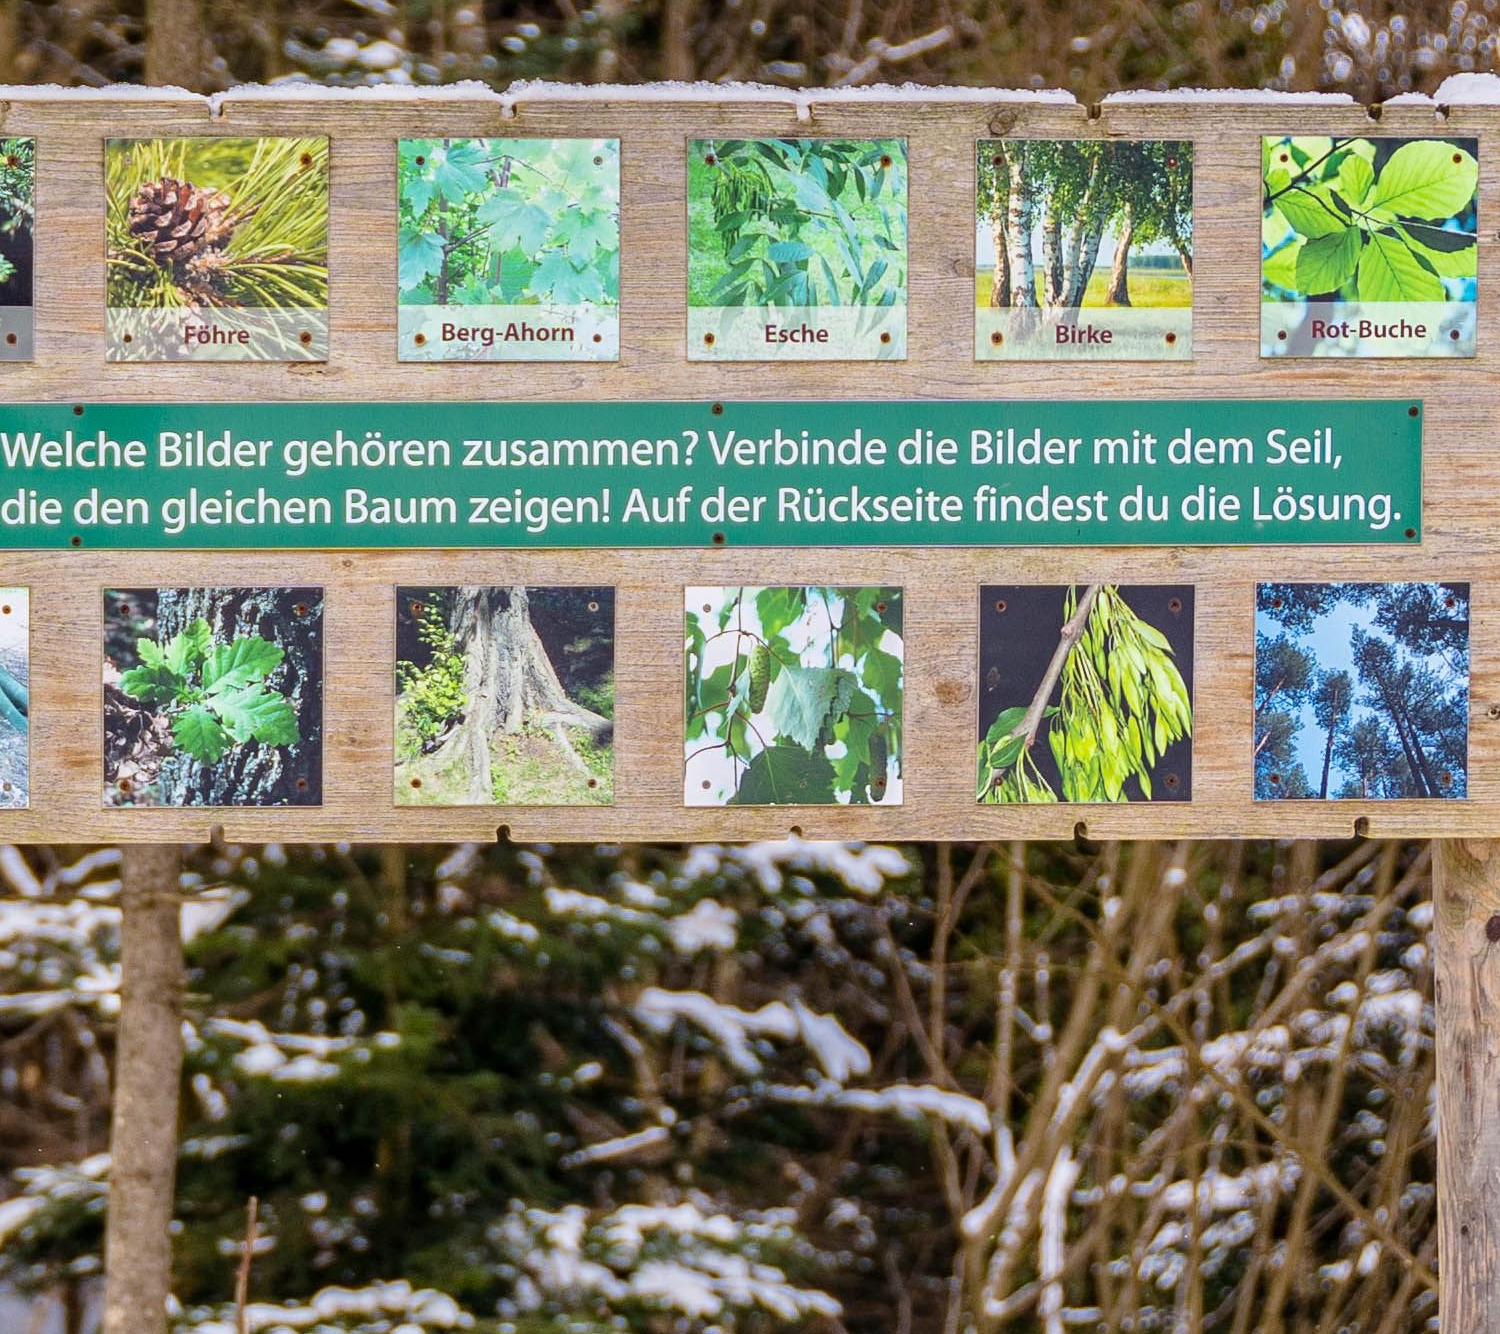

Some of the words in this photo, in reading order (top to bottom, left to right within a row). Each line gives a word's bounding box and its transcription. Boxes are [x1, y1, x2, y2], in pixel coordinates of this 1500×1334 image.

[184, 324, 250, 345] Föhre
[441, 322, 575, 347] Berg-Ahorn
[764, 323, 829, 344] Esche
[1055, 324, 1113, 345] Birke
[1311, 319, 1427, 339] Rot-Buche
[0, 430, 147, 468] Welche
[159, 430, 272, 468] Bilder
[283, 430, 451, 476] gehören
[462, 430, 699, 467] zusammen?
[707, 429, 887, 466] Verbinde
[899, 429, 959, 466] die
[971, 429, 1081, 466] Bilder
[1093, 428, 1156, 465] mit
[1167, 427, 1254, 465] dem
[1266, 427, 1342, 469] Seil,
[1, 488, 61, 525] die
[73, 488, 149, 525] den
[162, 488, 331, 534] gleichen
[345, 488, 456, 524] Baum
[468, 488, 610, 533] zeigen!
[621, 486, 692, 523] Auf
[701, 486, 767, 523] der
[777, 486, 963, 523] Rückseite
[974, 485, 1109, 523] findest
[1119, 485, 1169, 522] du
[1181, 485, 1240, 522] die
[1253, 485, 1401, 530] Lösung.
